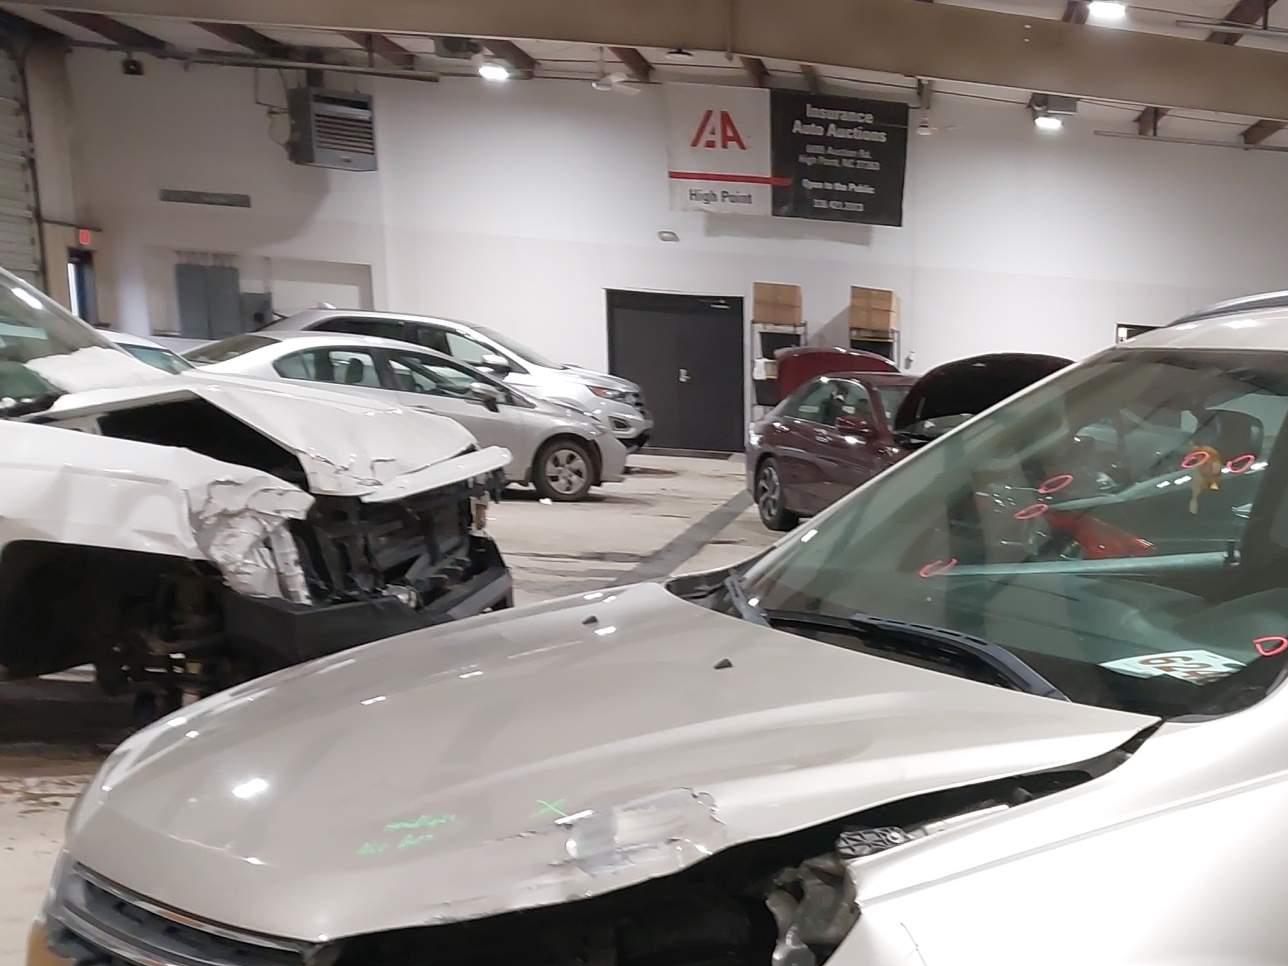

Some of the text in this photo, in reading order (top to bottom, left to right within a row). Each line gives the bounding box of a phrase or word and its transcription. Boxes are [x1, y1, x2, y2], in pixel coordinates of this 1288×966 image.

[805, 103, 874, 124] Insurance
[791, 119, 888, 143] Auto Auctions
[801, 178, 823, 190] Open
[848, 183, 876, 194] Public
[689, 189, 753, 205] High Point
